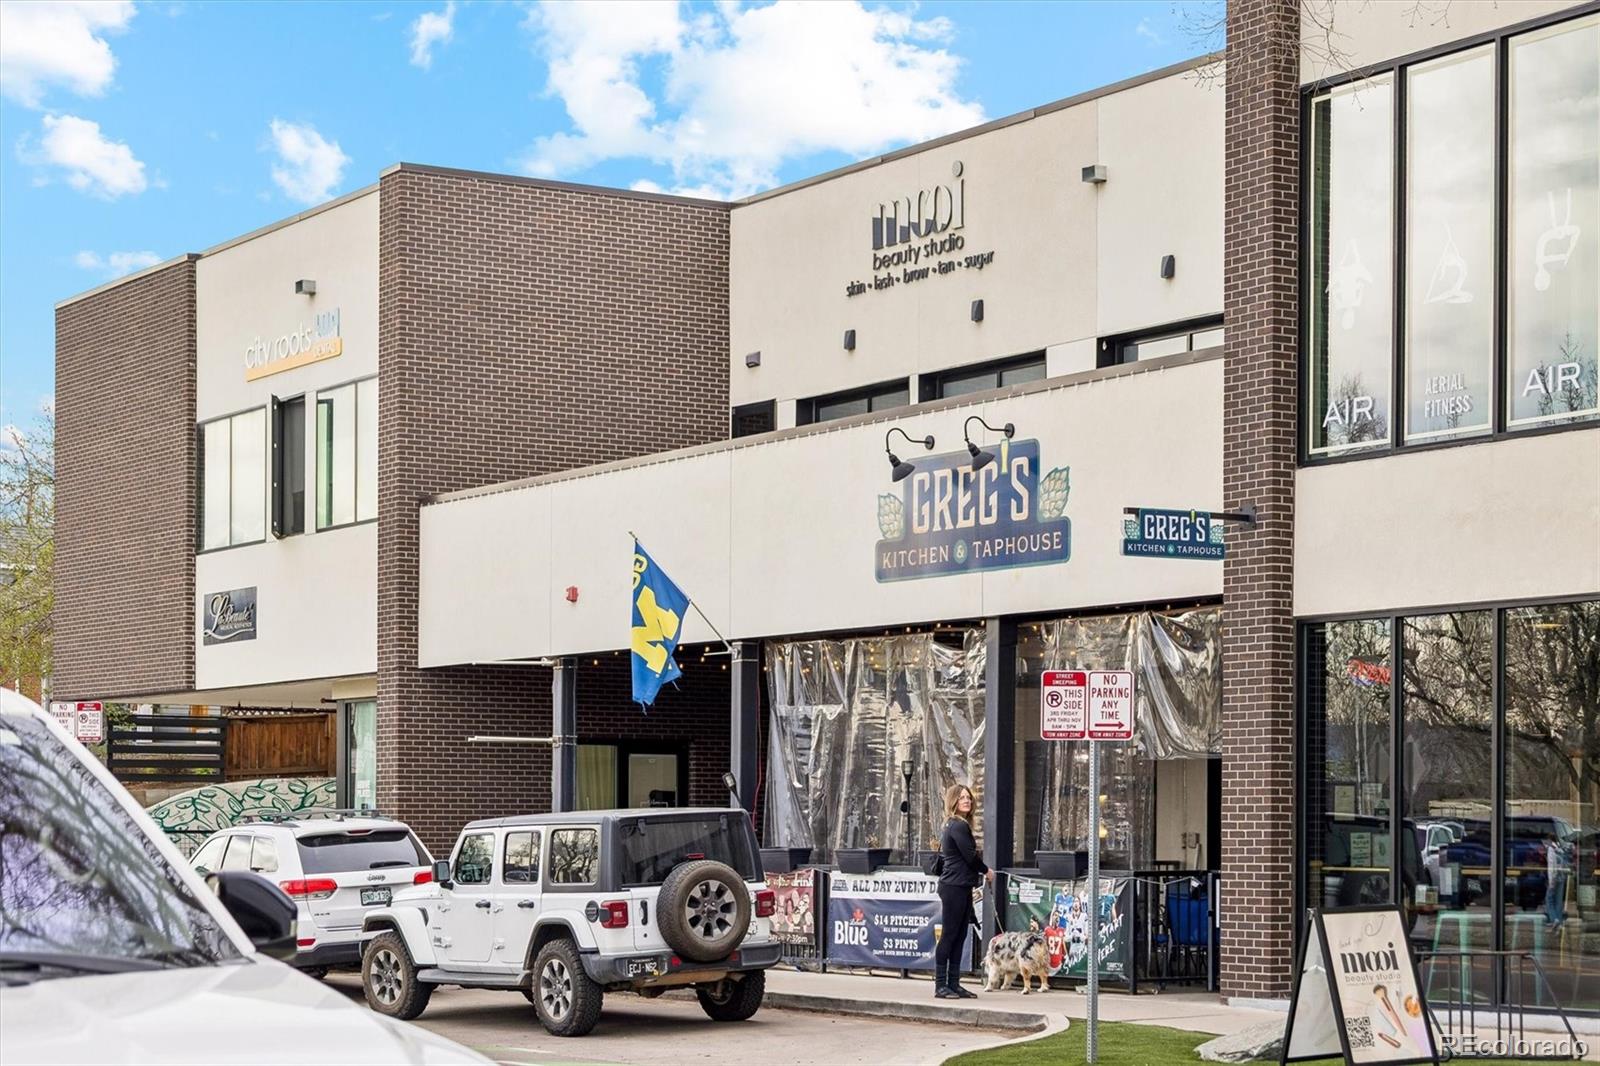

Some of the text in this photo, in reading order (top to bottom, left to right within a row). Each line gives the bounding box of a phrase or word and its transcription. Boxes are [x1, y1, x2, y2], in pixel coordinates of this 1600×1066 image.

[873, 232, 965, 271] beauty studio
[846, 250, 995, 297] skin lash brow tan sugar
[246, 320, 312, 369] city roots
[1424, 373, 1464, 395] AERIAL
[1522, 362, 1581, 397] AIR
[1322, 396, 1374, 428] AIR
[1424, 395, 1470, 418] FITNESS
[1144, 514, 1205, 542] GREG'S
[882, 531, 1062, 569] KITCHEN & TAPHOUSE
[1127, 543, 1165, 553] KITCHEN
[1177, 545, 1222, 556] TAPHOUSE
[1103, 674, 1118, 686] NO
[1064, 689, 1083, 699] THIS
[1091, 687, 1129, 699] PARKING
[1063, 700, 1083, 710] SIDE
[1101, 700, 1119, 709] ANY
[1100, 710, 1120, 720] TIME
[852, 880, 871, 892] ALL
[873, 880, 892, 892] DAY
[873, 914, 889, 926] $14
[890, 915, 930, 926] PITCHERS
[834, 920, 869, 945] Blue
[883, 937, 919, 950] $3 PINTS
[1048, 936, 1061, 955] 87
[1340, 942, 1400, 974] mooi
[1345, 974, 1374, 983] beauty
